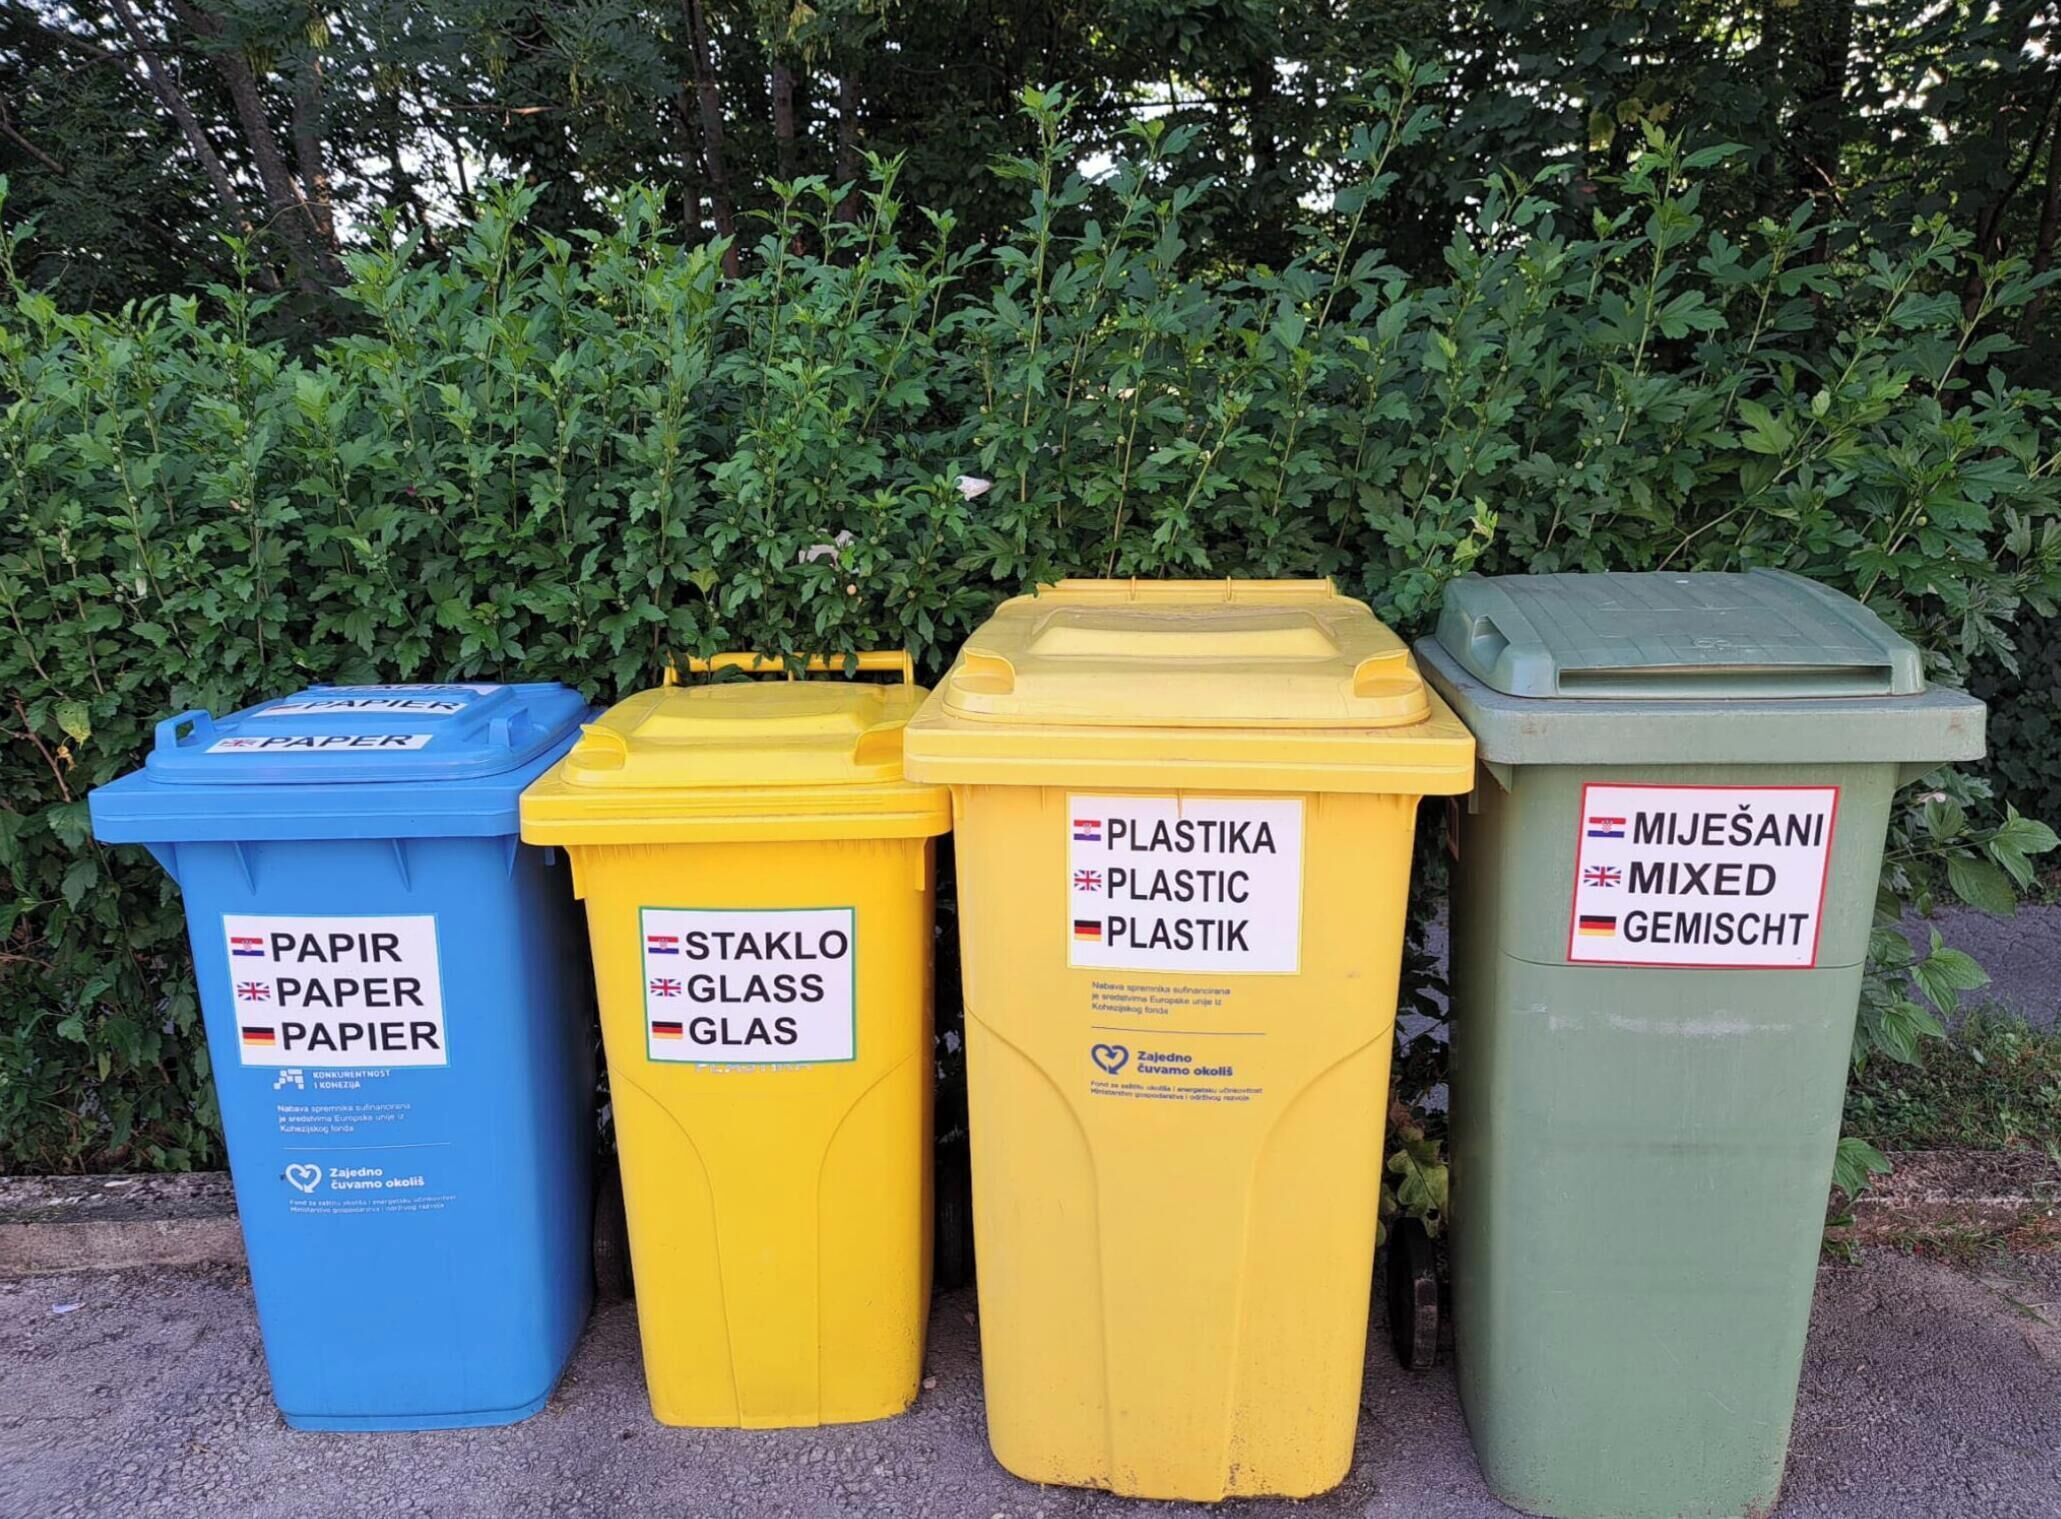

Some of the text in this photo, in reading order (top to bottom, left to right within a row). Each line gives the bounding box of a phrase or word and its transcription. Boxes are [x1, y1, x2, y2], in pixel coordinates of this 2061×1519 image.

[303, 699, 460, 711] PAPIER
[262, 734, 412, 748] PAPER
[1107, 818, 1276, 854] PLASTIKA
[1633, 804, 1824, 847] MIJEŠANI
[1107, 867, 1250, 903] PLASTIC
[1628, 861, 1777, 896] MIXED
[1107, 915, 1250, 951] PLASTIK
[1623, 910, 1809, 946] GEMISCHT
[270, 932, 403, 963] PAPIR
[685, 930, 848, 961] STAKLO
[276, 977, 424, 1008] PAPER
[687, 973, 825, 1004] GLASS
[281, 1021, 440, 1052] PAPIER
[689, 1016, 799, 1046] GLAS
[1137, 1051, 1192, 1063] Zajedno
[1137, 1065, 1233, 1077] čuvamo okoliš
[313, 1070, 391, 1080] KONKURENTNOST
[320, 1080, 361, 1090] KOHEZIJA
[330, 1167, 383, 1179] Zajedno
[331, 1176, 425, 1190] čuvamo okoliš
